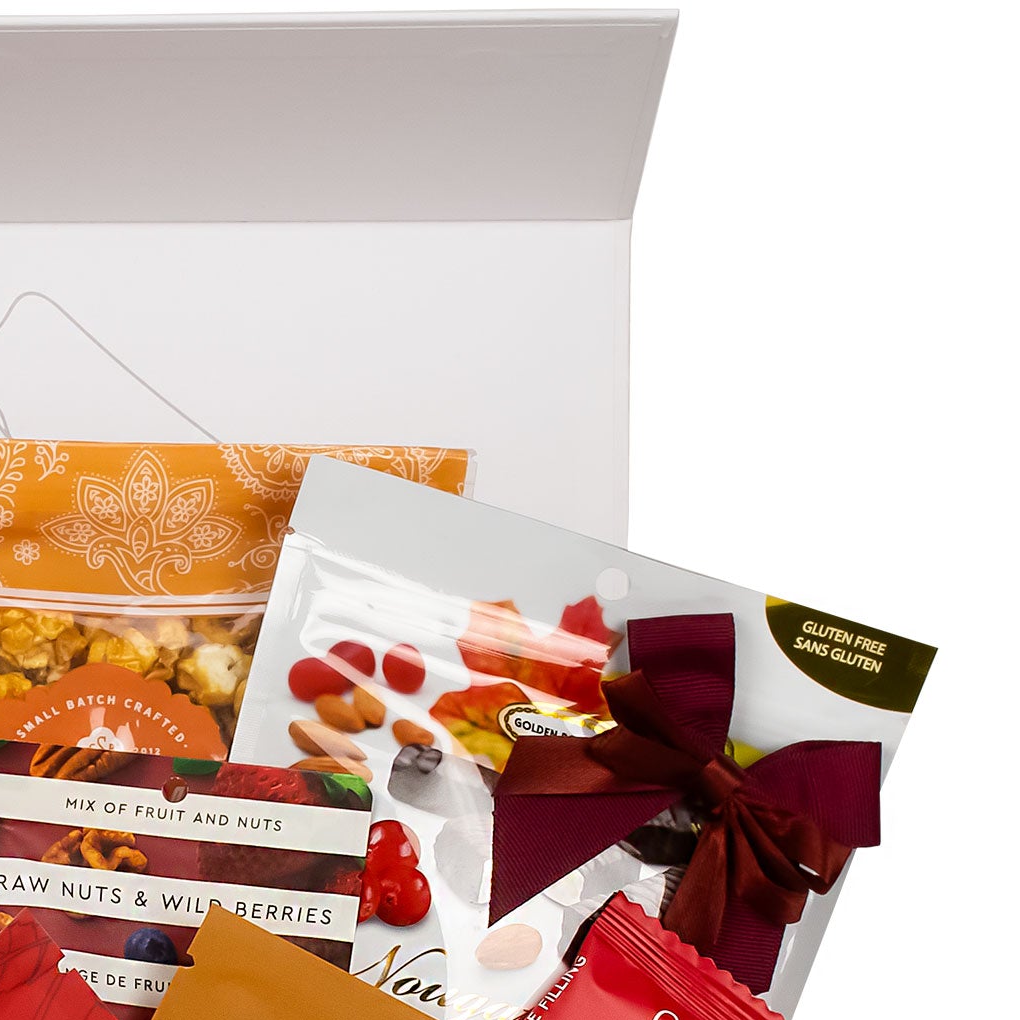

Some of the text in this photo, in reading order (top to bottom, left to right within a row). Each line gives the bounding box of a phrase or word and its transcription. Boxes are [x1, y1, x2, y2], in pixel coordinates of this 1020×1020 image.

[793, 637, 883, 674] SANS GLUTEN
[802, 620, 887, 656] GLUTEN FREE
[16, 705, 61, 740] SMALL
[65, 694, 117, 711] BATCH
[65, 797, 283, 833] MIX OF FRUIT AND NUTS
[61, 880, 122, 905] NUTS
[134, 890, 148, 908] &
[235, 901, 332, 926] BERRIES
[106, 974, 126, 988] DE
[537, 955, 587, 1011] FILLING
